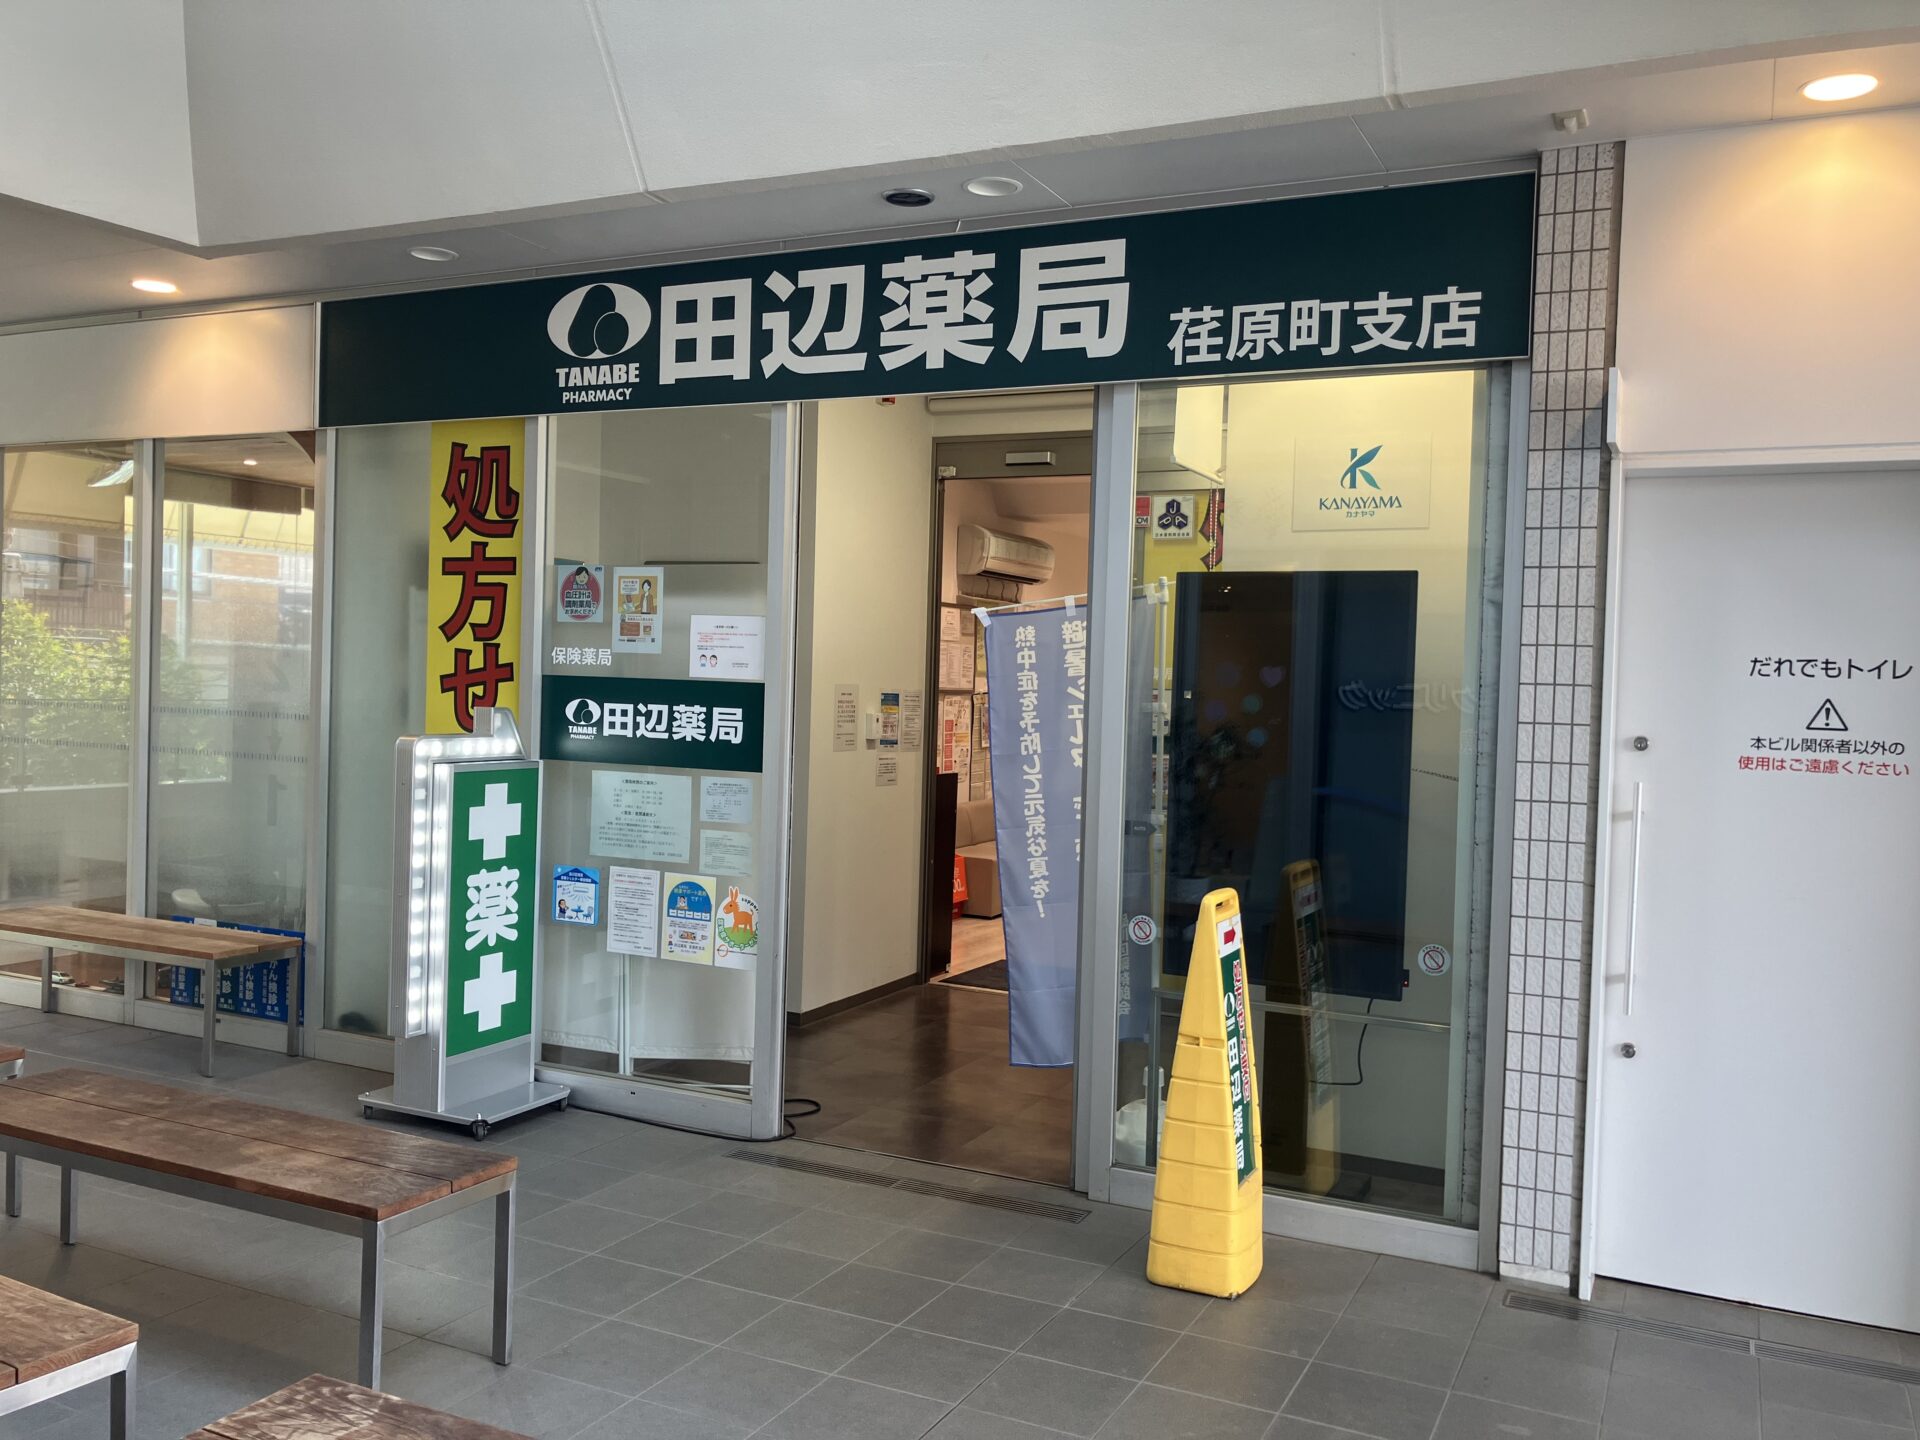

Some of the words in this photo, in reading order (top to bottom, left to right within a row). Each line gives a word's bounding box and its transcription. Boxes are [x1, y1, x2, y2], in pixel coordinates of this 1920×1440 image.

[658, 238, 1130, 385] 田辺薬局
[1167, 286, 1482, 366] 荏原町支店
[555, 363, 640, 388] TANABE
[562, 387, 632, 404] PHARMACY
[1319, 496, 1402, 510] KANAYAMA
[1346, 510, 1375, 519] カナヤマ
[551, 646, 612, 666] 保険薬局
[1749, 657, 1913, 680] だれでもトイレ
[568, 725, 597, 735] TANABE
[603, 702, 744, 744] 田辺薬局
[1750, 736, 1905, 756] 本ビル関係者以外の
[1738, 755, 1910, 776] 使用はご遠慮ください
[465, 865, 520, 951] 薬
